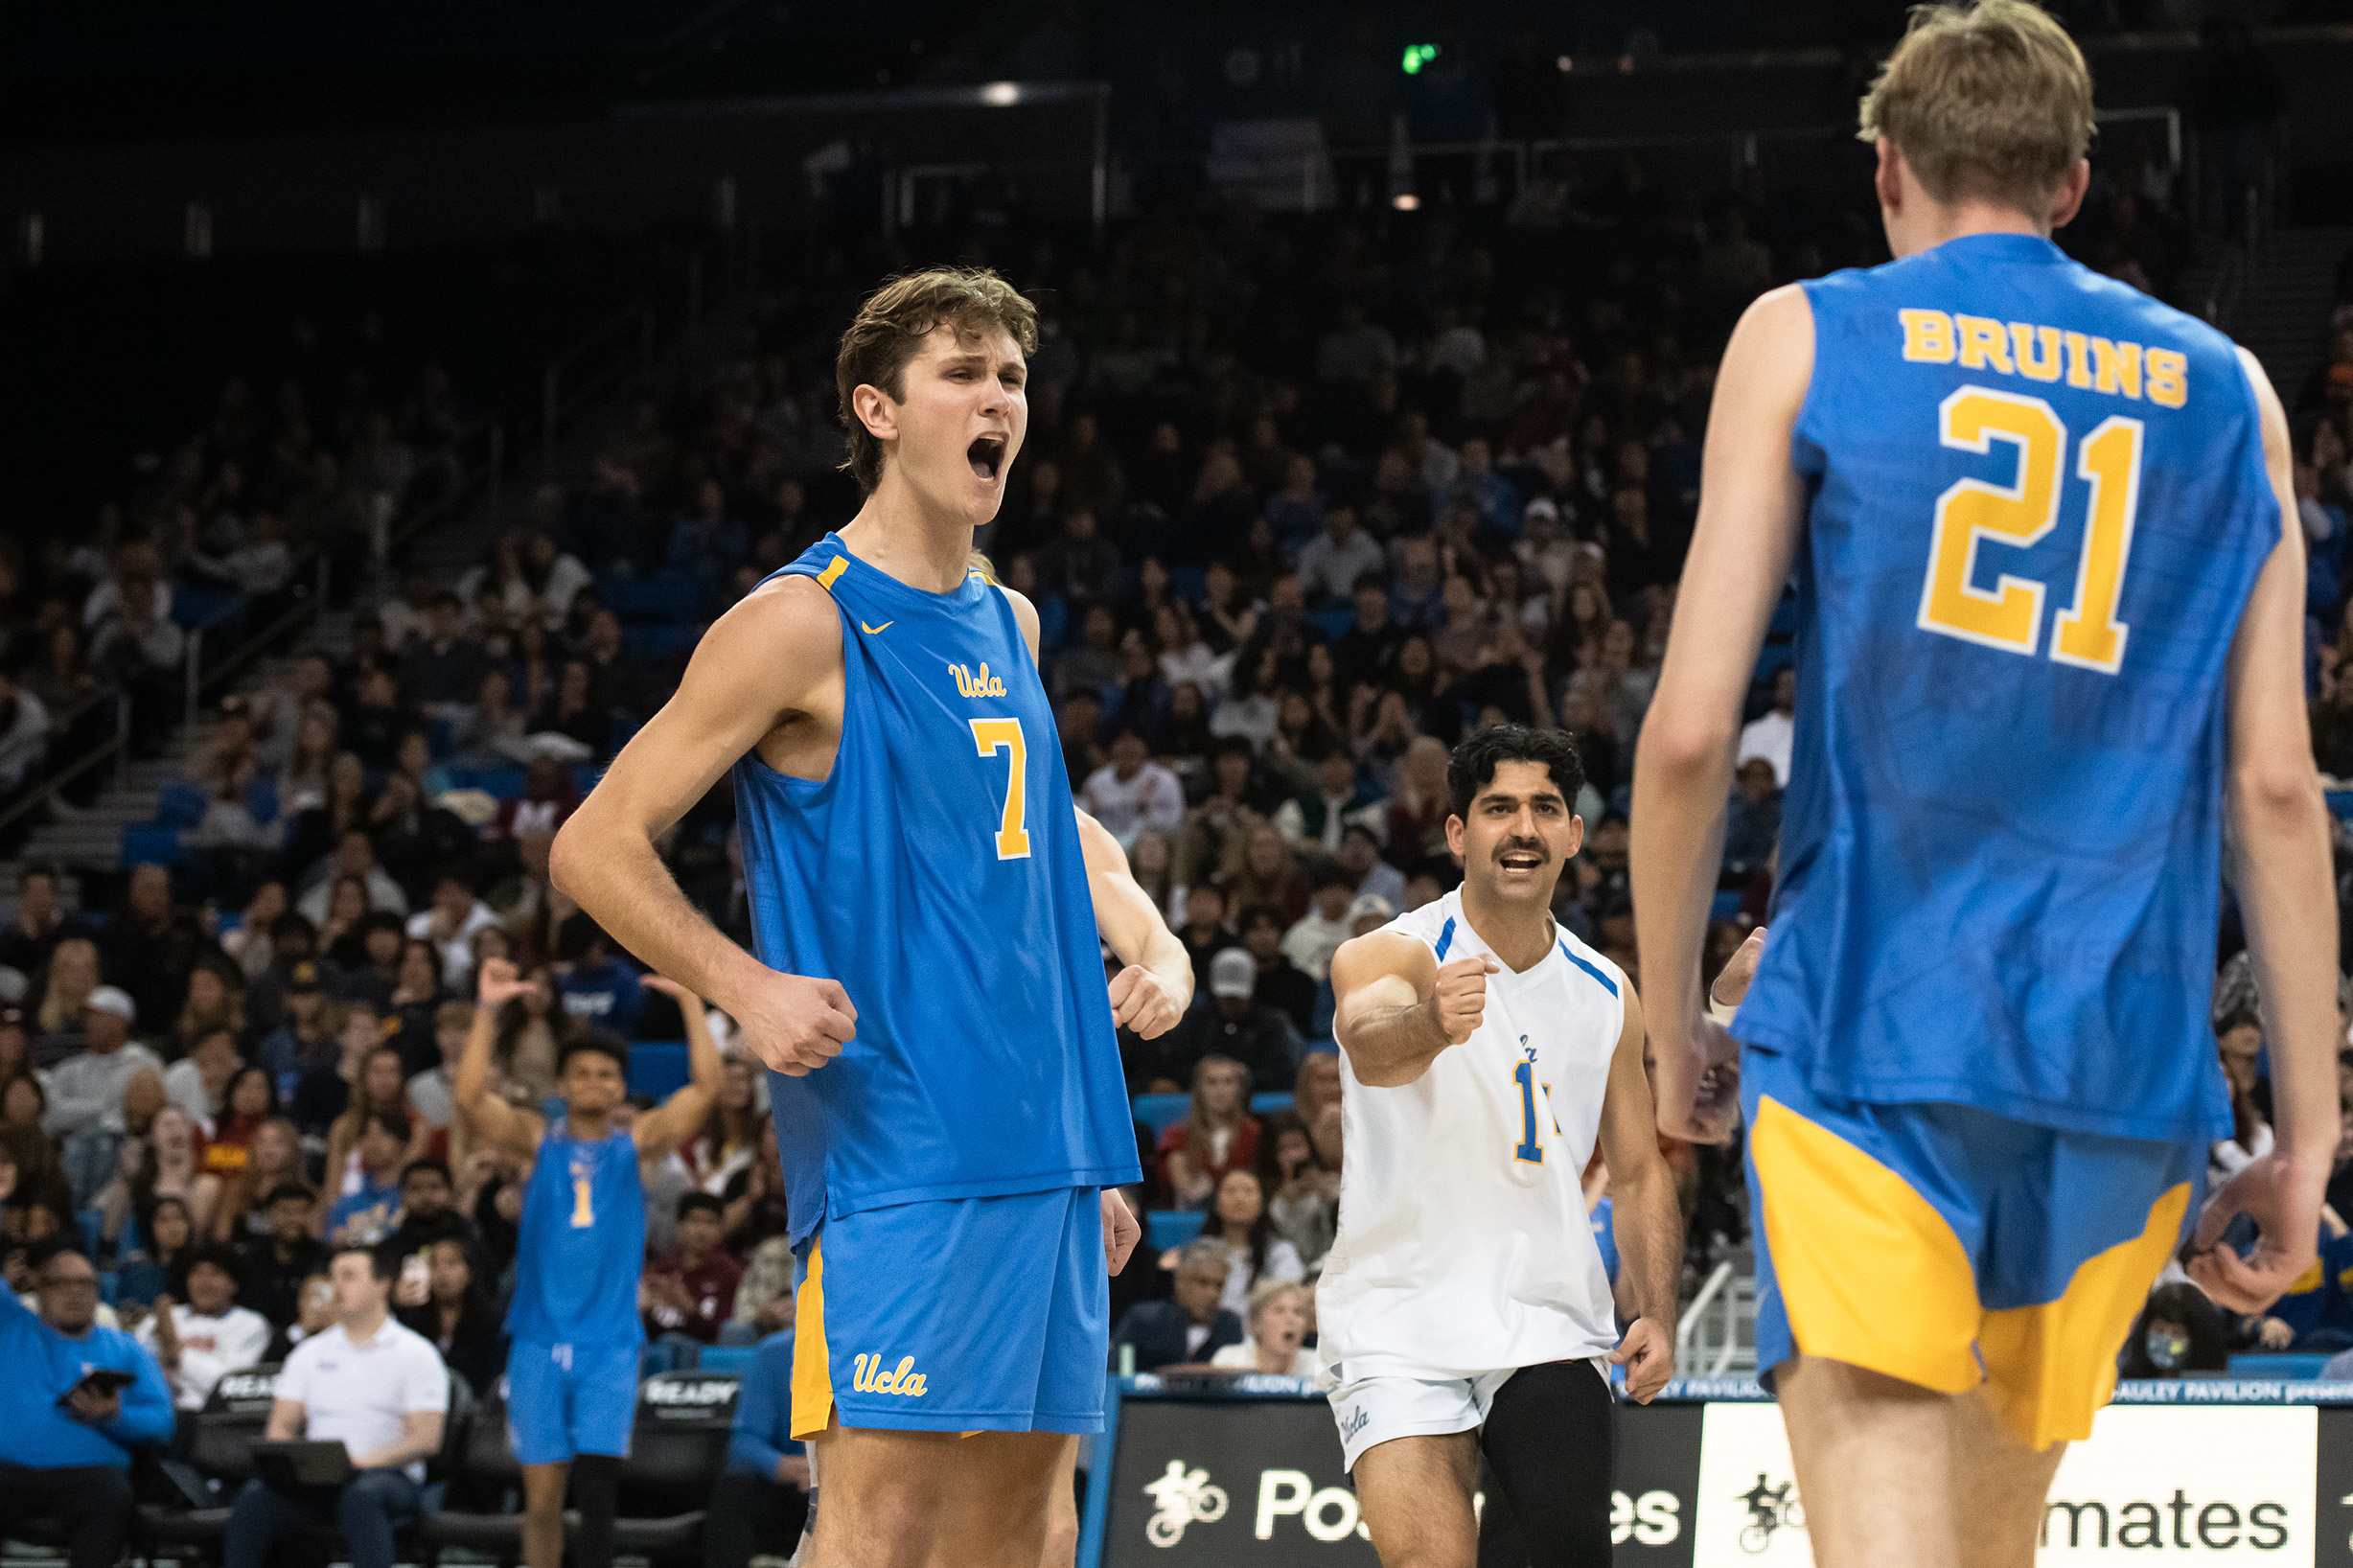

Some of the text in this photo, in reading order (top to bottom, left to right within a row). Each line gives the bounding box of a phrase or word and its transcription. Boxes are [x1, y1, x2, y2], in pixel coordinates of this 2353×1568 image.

[1900, 309, 2188, 408] BRUINS
[1917, 384, 2145, 675] 21
[948, 661, 1007, 698] Ucla
[968, 717, 1031, 861] 7
[646, 1380, 739, 1404] READY
[853, 1353, 929, 1397] Ucla
[2111, 1379, 2183, 1401] AULEY
[2184, 1380, 2282, 1402] PAVILION
